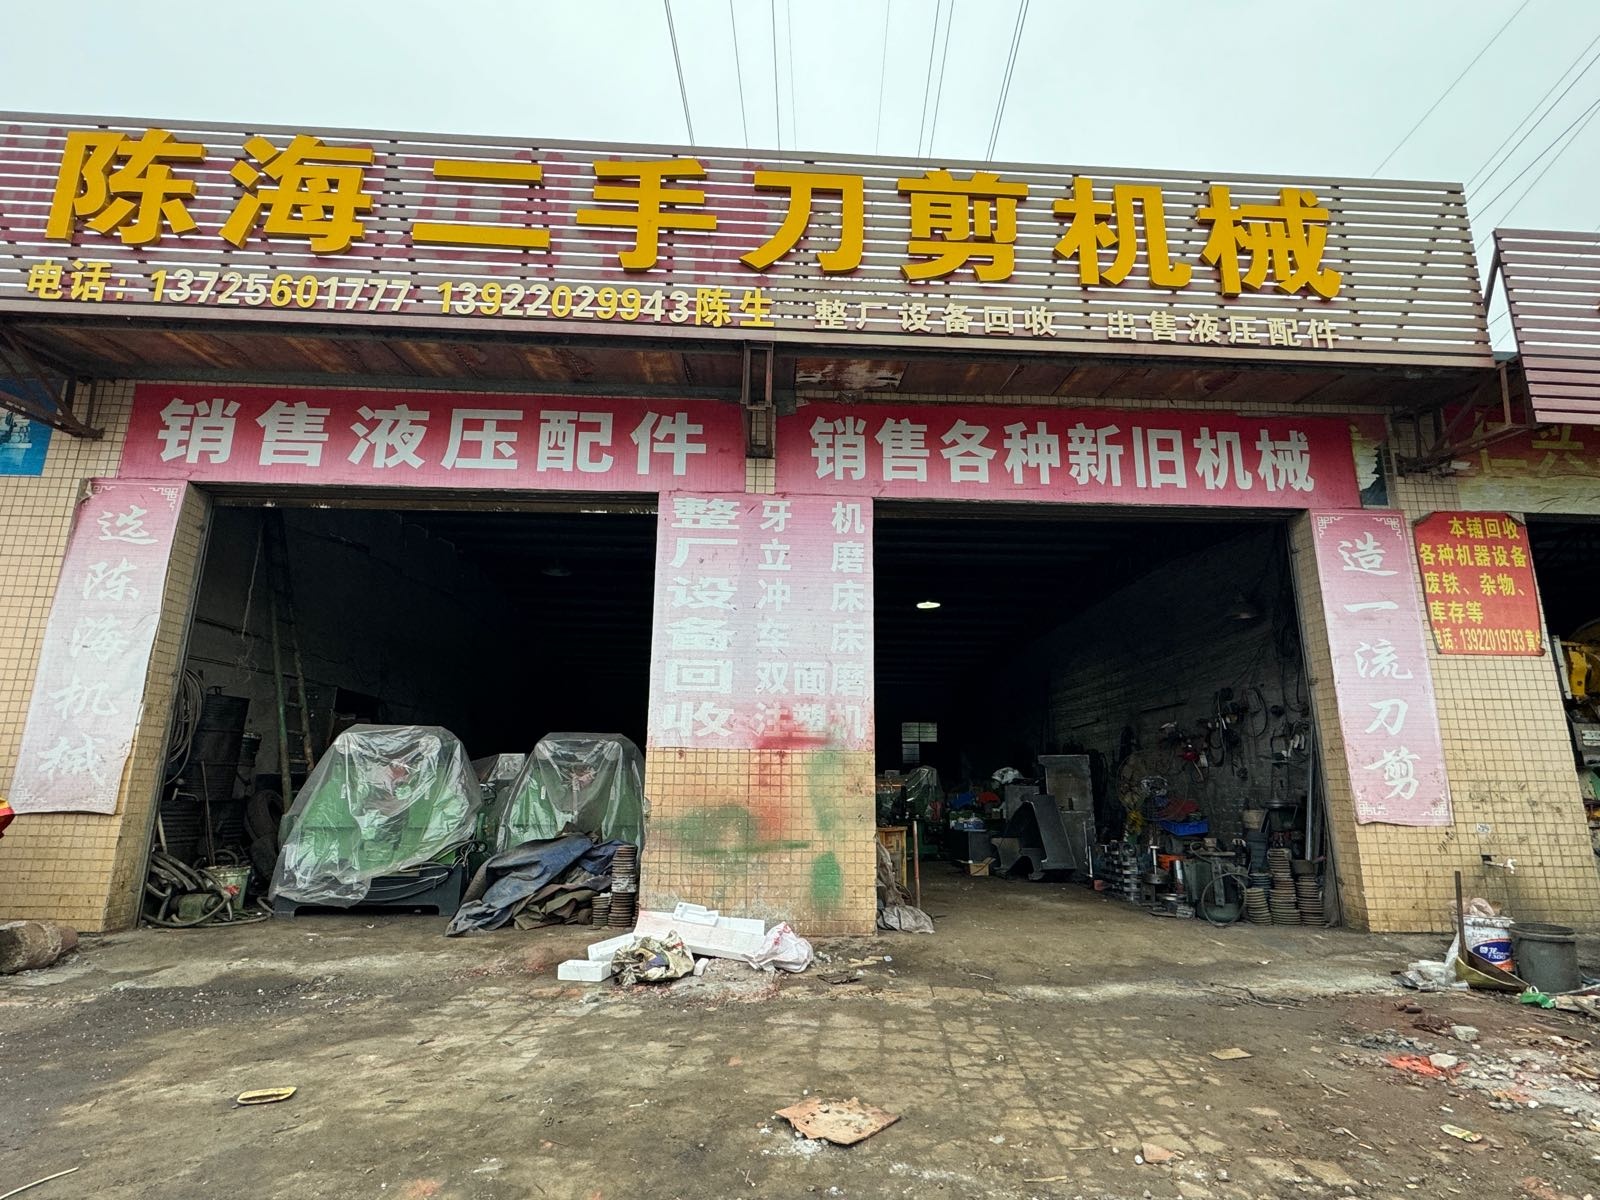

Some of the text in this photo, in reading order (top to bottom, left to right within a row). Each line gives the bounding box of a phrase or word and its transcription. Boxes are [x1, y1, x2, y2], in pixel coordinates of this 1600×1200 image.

[44, 128, 1342, 302] 陈海二手刀剪机械
[814, 298, 1058, 336] 整厂设备回收
[1107, 309, 1340, 349] 出售液压配件
[157, 398, 707, 477] 销售液压配件
[810, 416, 1315, 494] 销售各种新旧机械
[1419, 543, 1528, 568] 各种机器设备
[1448, 516, 1520, 540] 本铺回收
[38, 504, 159, 786] 选陈海机械
[663, 497, 741, 737] 整厂设备回收
[1430, 600, 1484, 625] 库存等
[1337, 531, 1421, 800] 造一流刀剪
